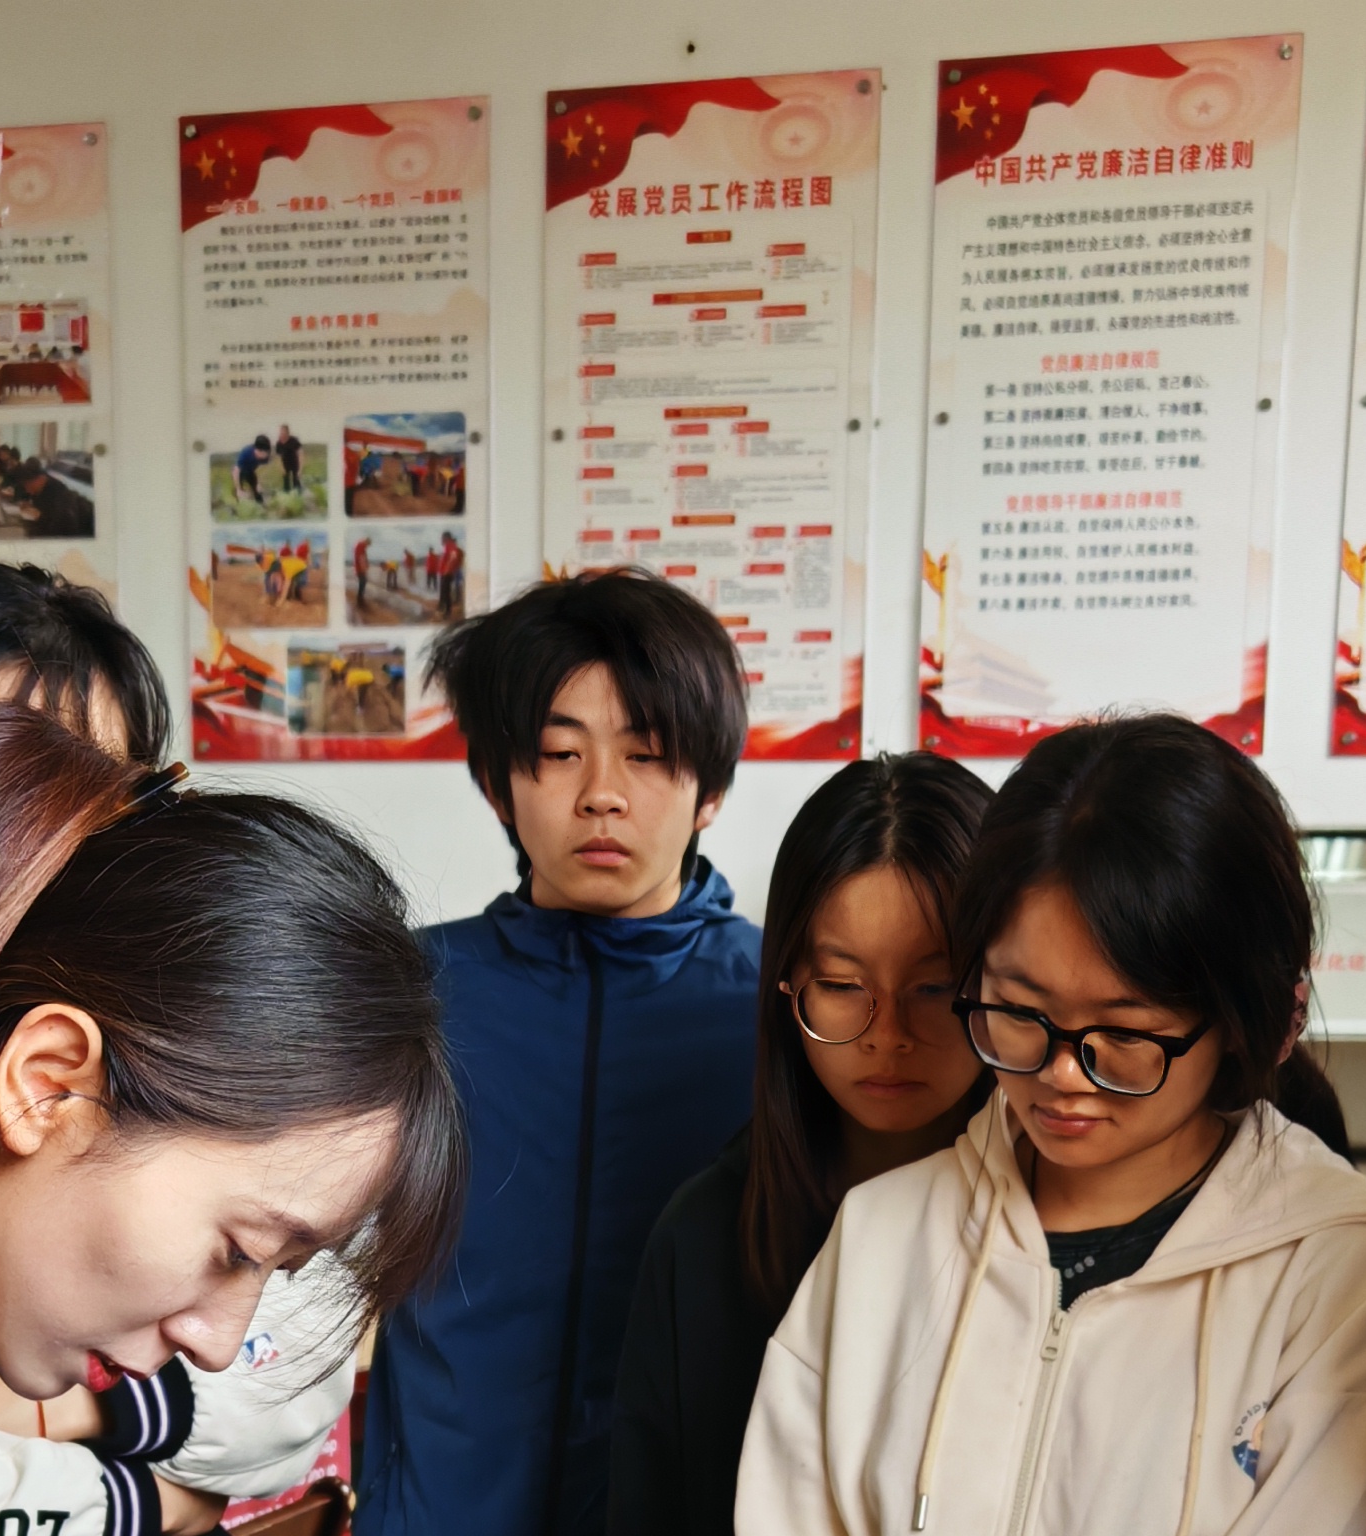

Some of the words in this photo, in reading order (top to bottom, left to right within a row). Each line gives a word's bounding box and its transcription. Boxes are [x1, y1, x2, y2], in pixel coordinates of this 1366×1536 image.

[974, 139, 1255, 188] 中国共产党廉洁自律准则
[588, 175, 833, 219] 发展党员工作流程图
